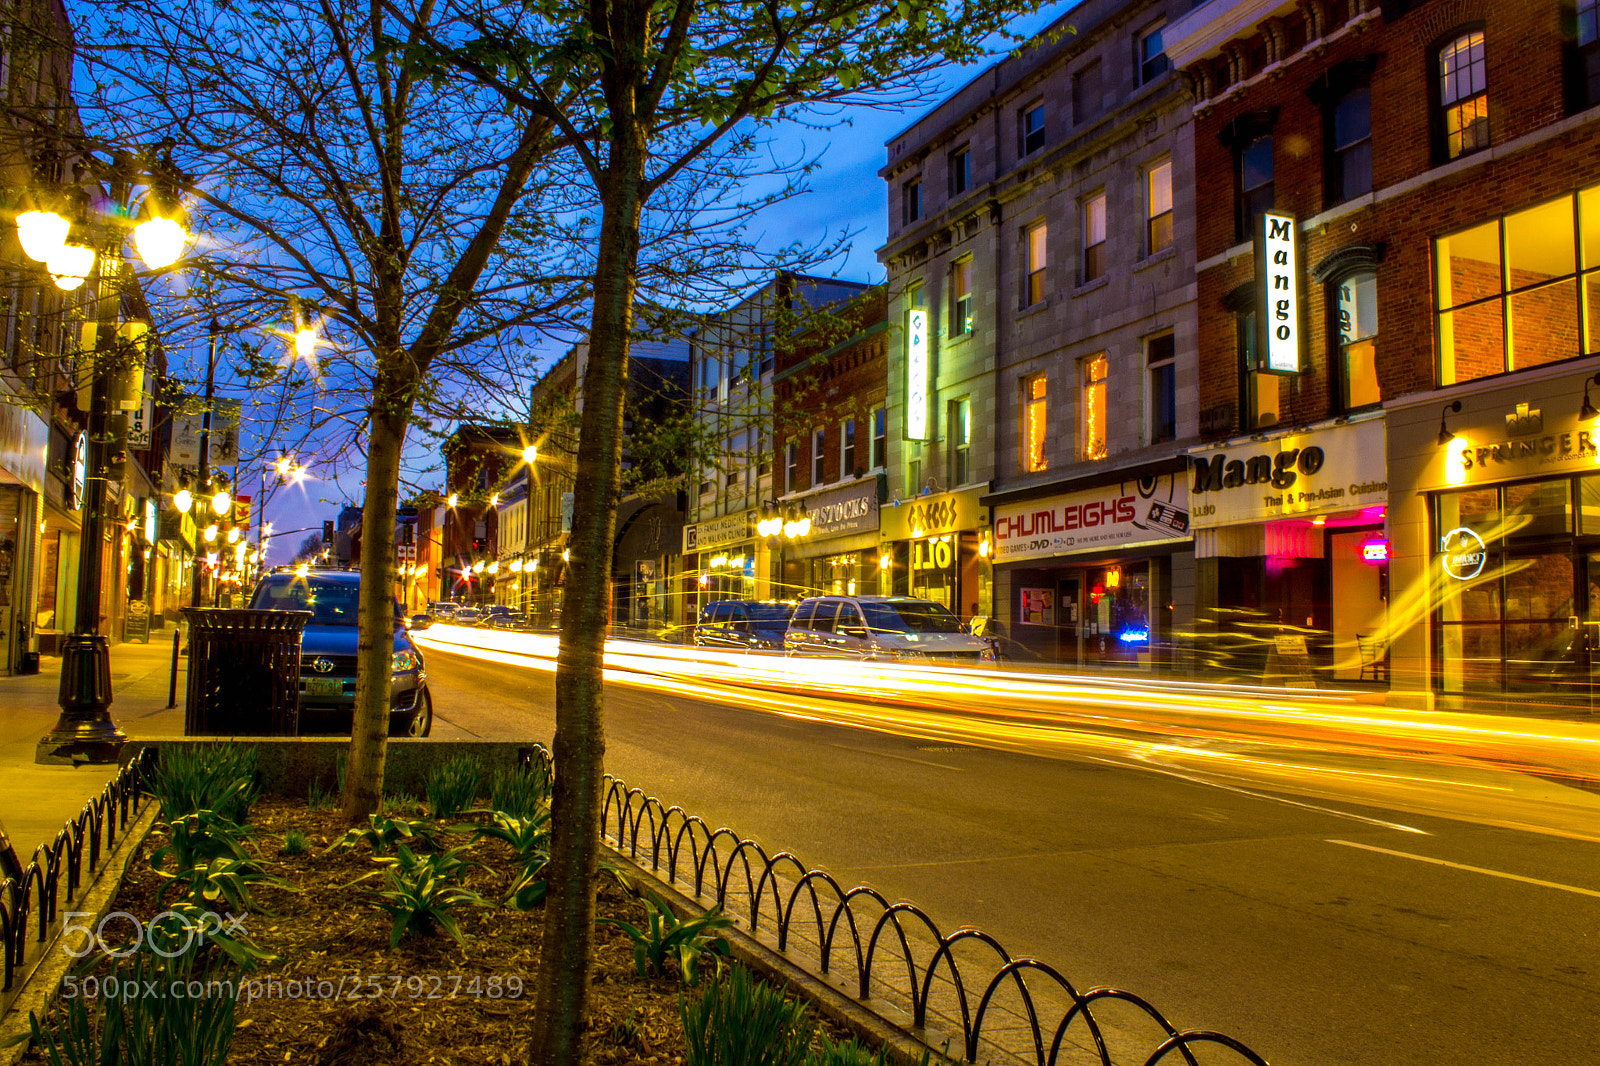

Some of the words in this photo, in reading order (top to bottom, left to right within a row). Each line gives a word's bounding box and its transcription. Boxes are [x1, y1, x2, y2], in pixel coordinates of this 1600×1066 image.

[1269, 219, 1291, 340] Mango
[1192, 446, 1325, 494] Mango
[1461, 431, 1597, 470] SPRINGER
[1264, 494, 1283, 507] Thai
[1288, 494, 1294, 504] &
[1299, 487, 1344, 503] Pan-Asian
[1349, 480, 1387, 495] Cuisine
[728, 528, 746, 541] CLINIC
[996, 496, 1136, 540] CHUMLEIGHS
[1029, 539, 1049, 551] DVD
